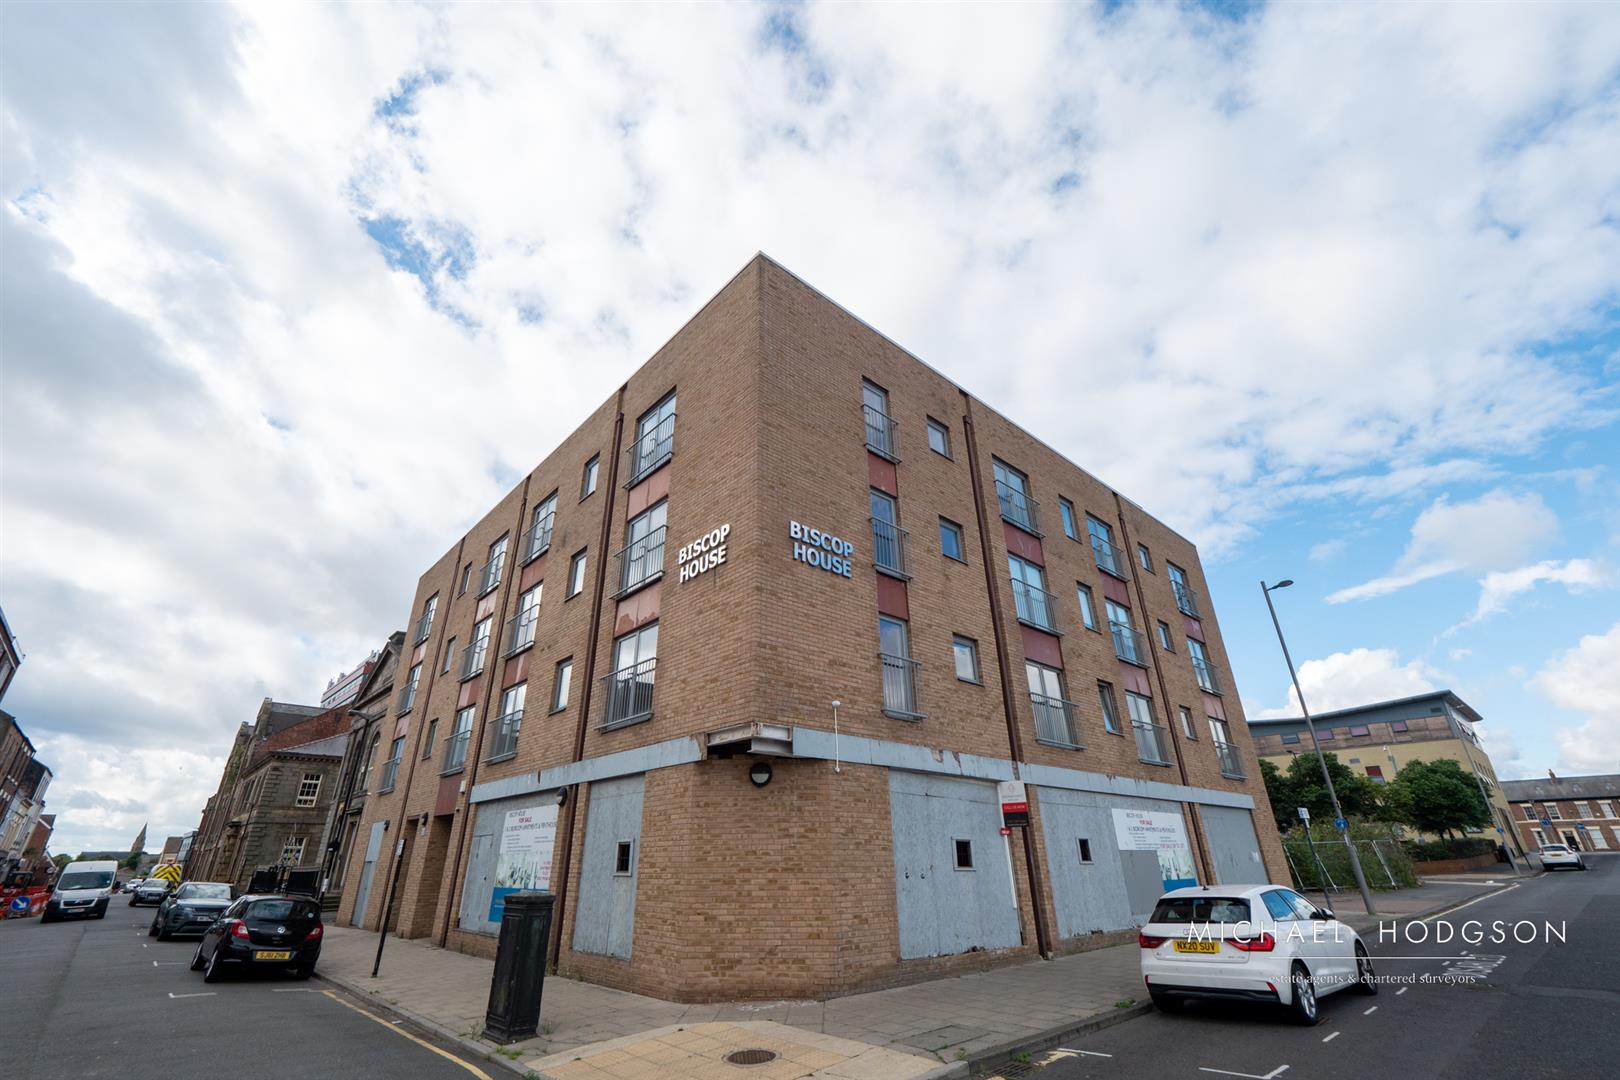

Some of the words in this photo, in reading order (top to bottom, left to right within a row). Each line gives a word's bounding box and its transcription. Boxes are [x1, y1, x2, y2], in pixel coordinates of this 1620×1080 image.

[678, 523, 730, 565] BISCOP
[789, 520, 854, 557] BISCOP
[679, 545, 727, 584] HOUSE
[793, 542, 852, 578] HOUSE
[1177, 941, 1198, 950] NX20
[1199, 942, 1215, 951] SUV
